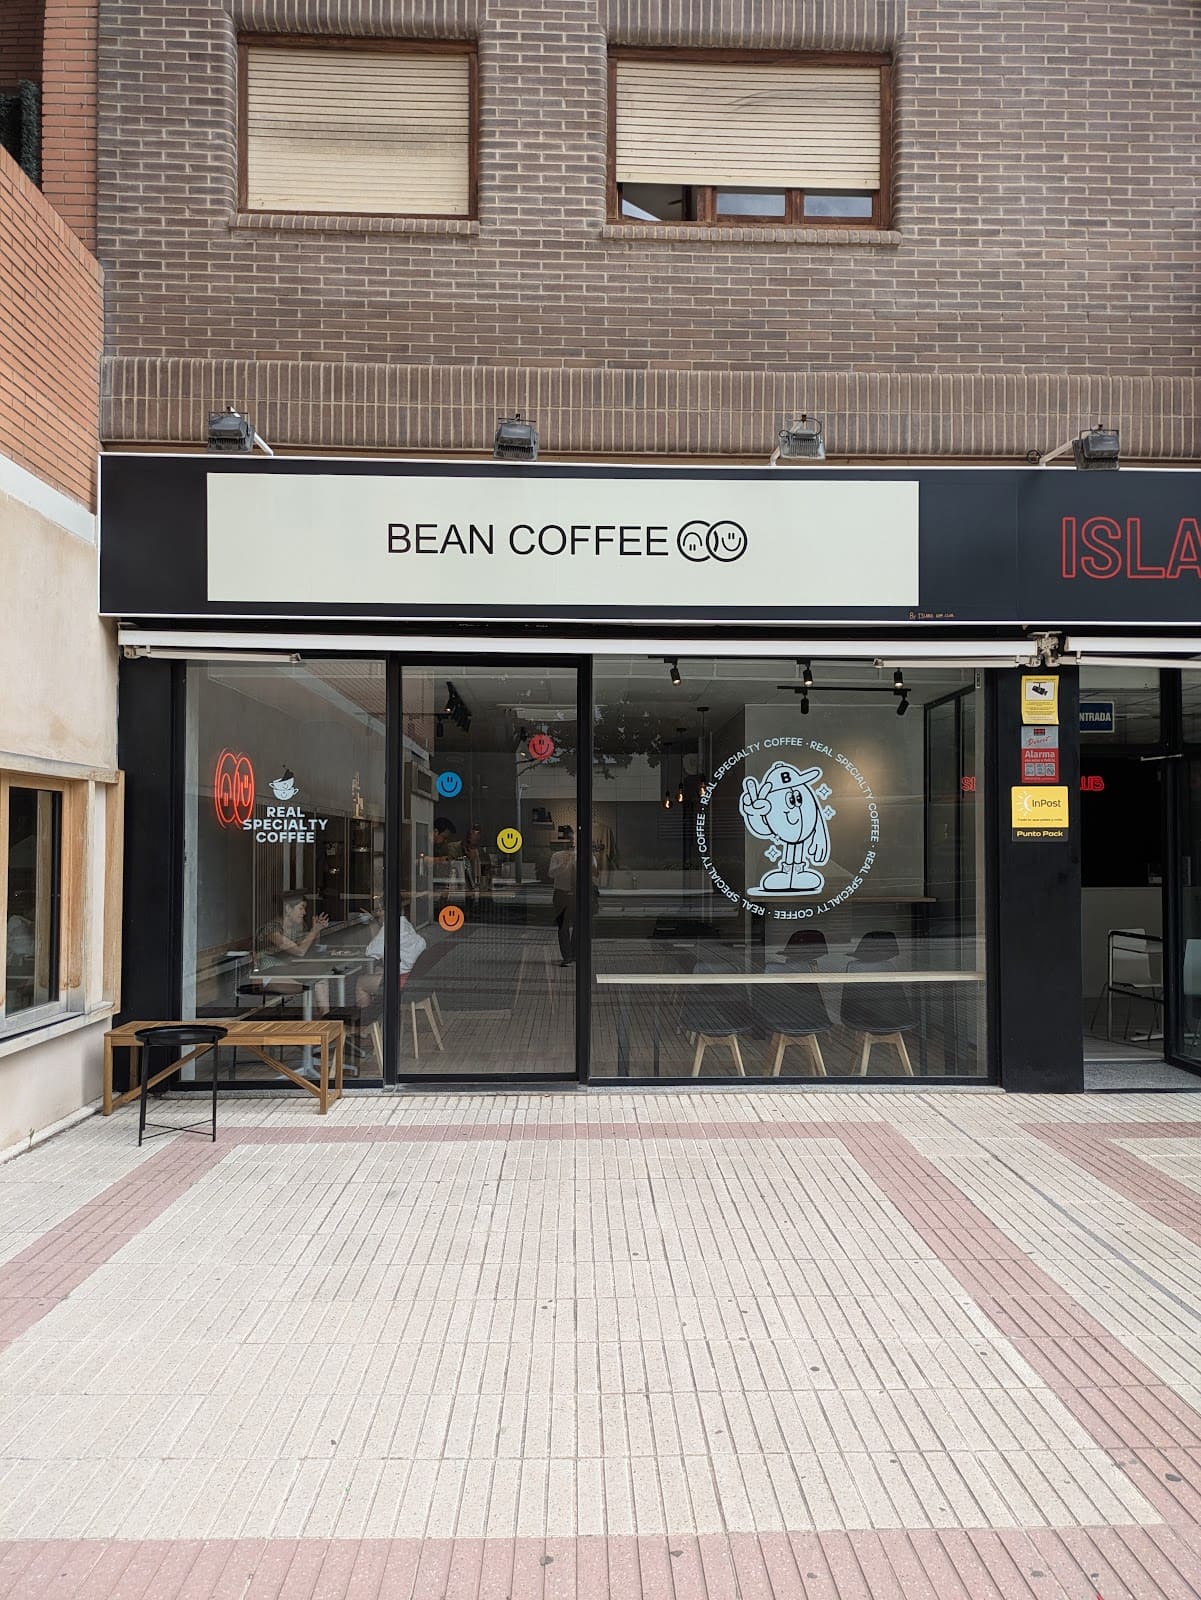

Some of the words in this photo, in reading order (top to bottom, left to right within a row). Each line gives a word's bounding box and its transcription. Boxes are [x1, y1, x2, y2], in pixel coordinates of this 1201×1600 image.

[387, 523, 494, 555] BEAN
[508, 524, 669, 557] COFFEE
[1061, 516, 1201, 580] ISLA
[1024, 750, 1056, 759] Alarma
[700, 781, 717, 805] REAL
[714, 742, 760, 779] SPECIALTY
[764, 737, 803, 748] COFFEE
[780, 771, 792, 784] B
[810, 741, 833, 757] REAL
[835, 752, 873, 800] SPECIALTY
[868, 803, 880, 843] COFFEE
[267, 807, 305, 818] REAL
[1032, 799, 1062, 808] InPost
[243, 820, 328, 830] SPECIALTY
[695, 814, 708, 853] COFFEE
[256, 832, 315, 843] COFFEE
[859, 850, 876, 874] REAL
[700, 855, 739, 903] SPECIALTY
[817, 876, 864, 915] SPECIALTY
[742, 898, 765, 916] REAL
[773, 908, 814, 920] COFFEE
